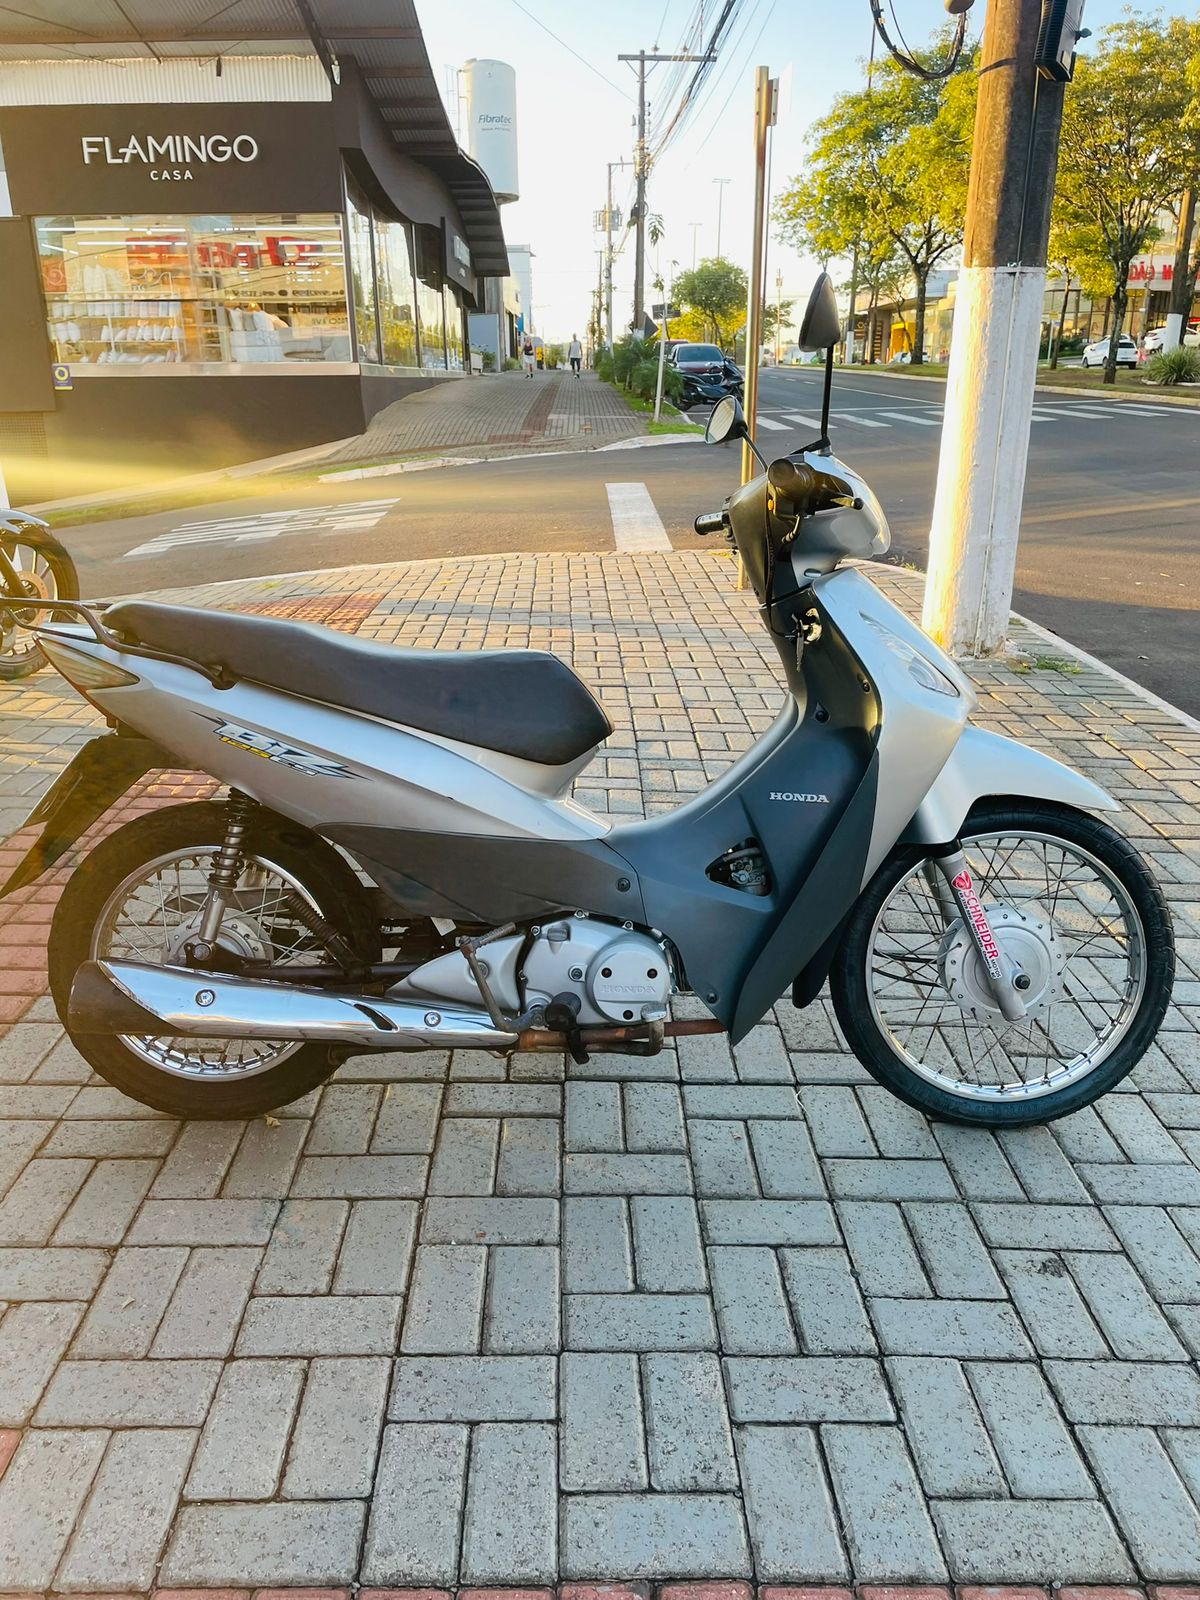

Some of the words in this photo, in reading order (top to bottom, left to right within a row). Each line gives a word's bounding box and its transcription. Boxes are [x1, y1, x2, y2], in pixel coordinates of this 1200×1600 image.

[478, 114, 512, 124] Fibratec
[81, 134, 258, 164] FLAMINGO
[150, 170, 193, 181] CASA
[769, 791, 830, 803] HONDA
[963, 889, 999, 959] SCHNEIDER
[991, 958, 1002, 977] MOTOS
[601, 984, 656, 993] HONDA
